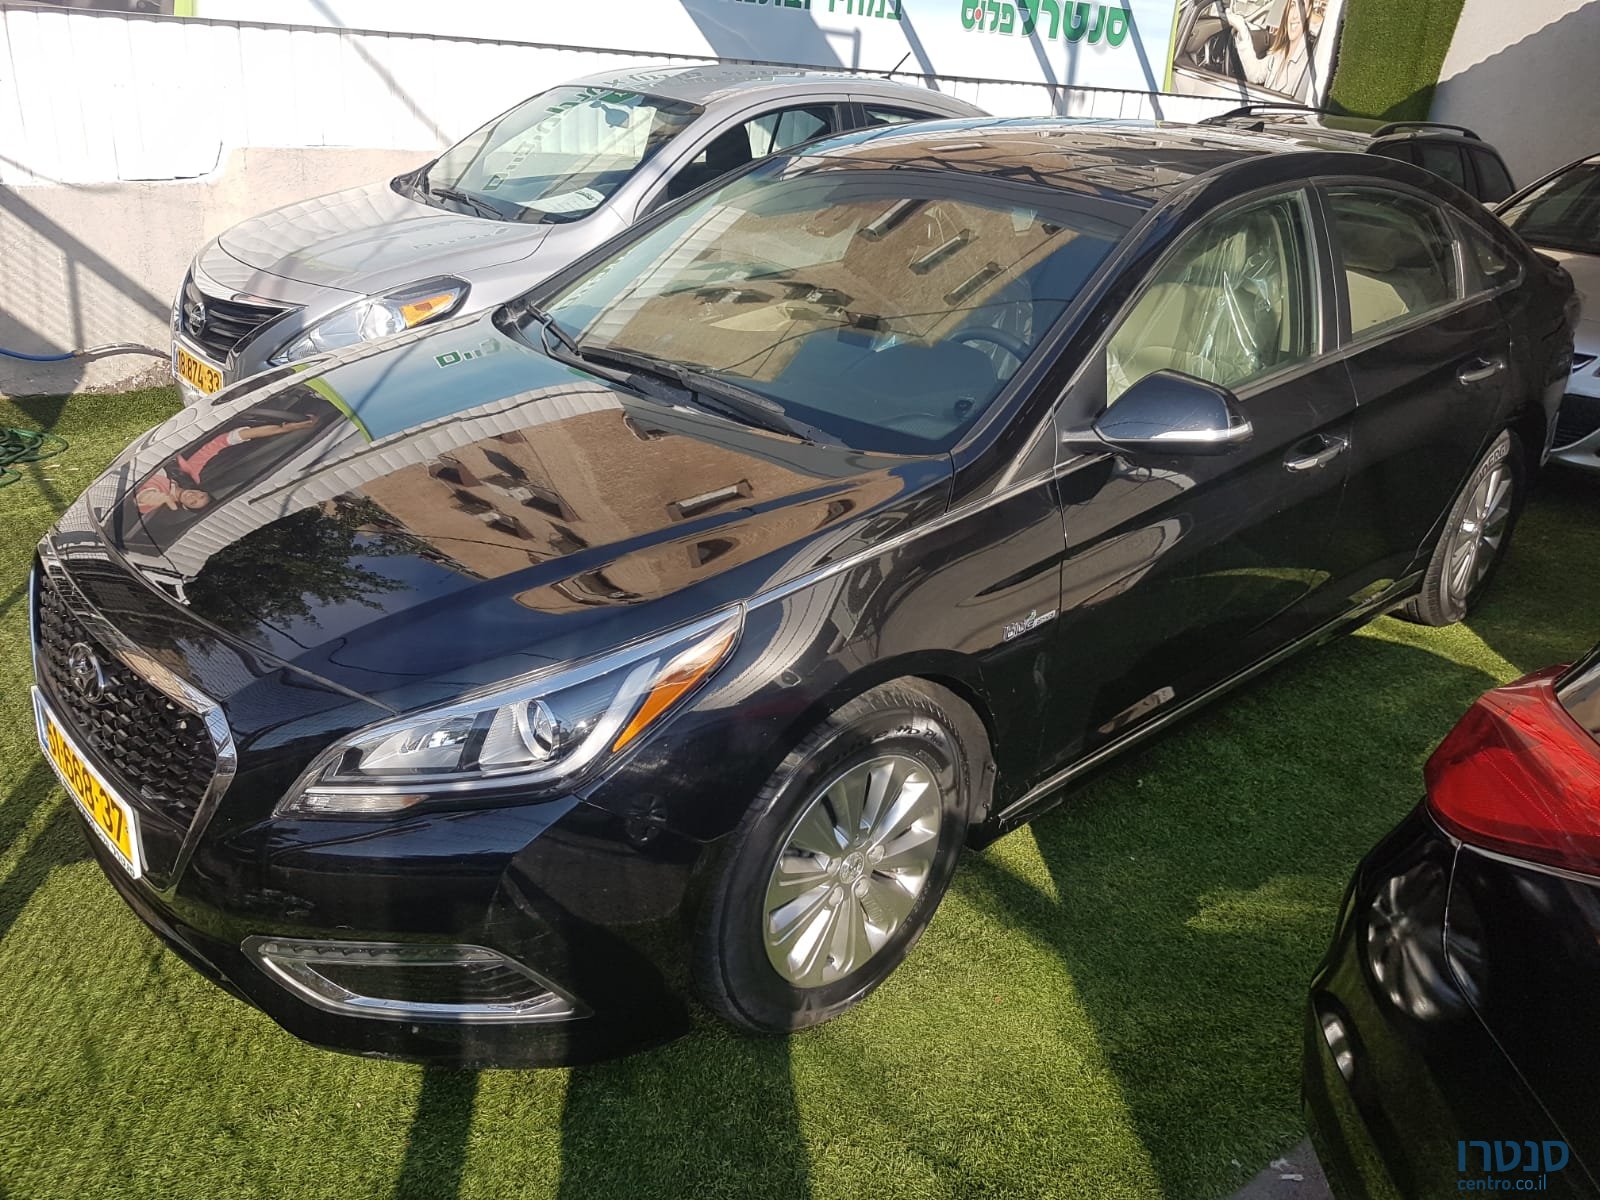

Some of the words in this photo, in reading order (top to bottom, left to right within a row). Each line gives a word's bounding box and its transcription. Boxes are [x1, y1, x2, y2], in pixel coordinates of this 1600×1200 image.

[828, 0, 901, 20] במח
[961, 0, 1015, 34] פלוס
[1017, 0, 1130, 47] סנטרל
